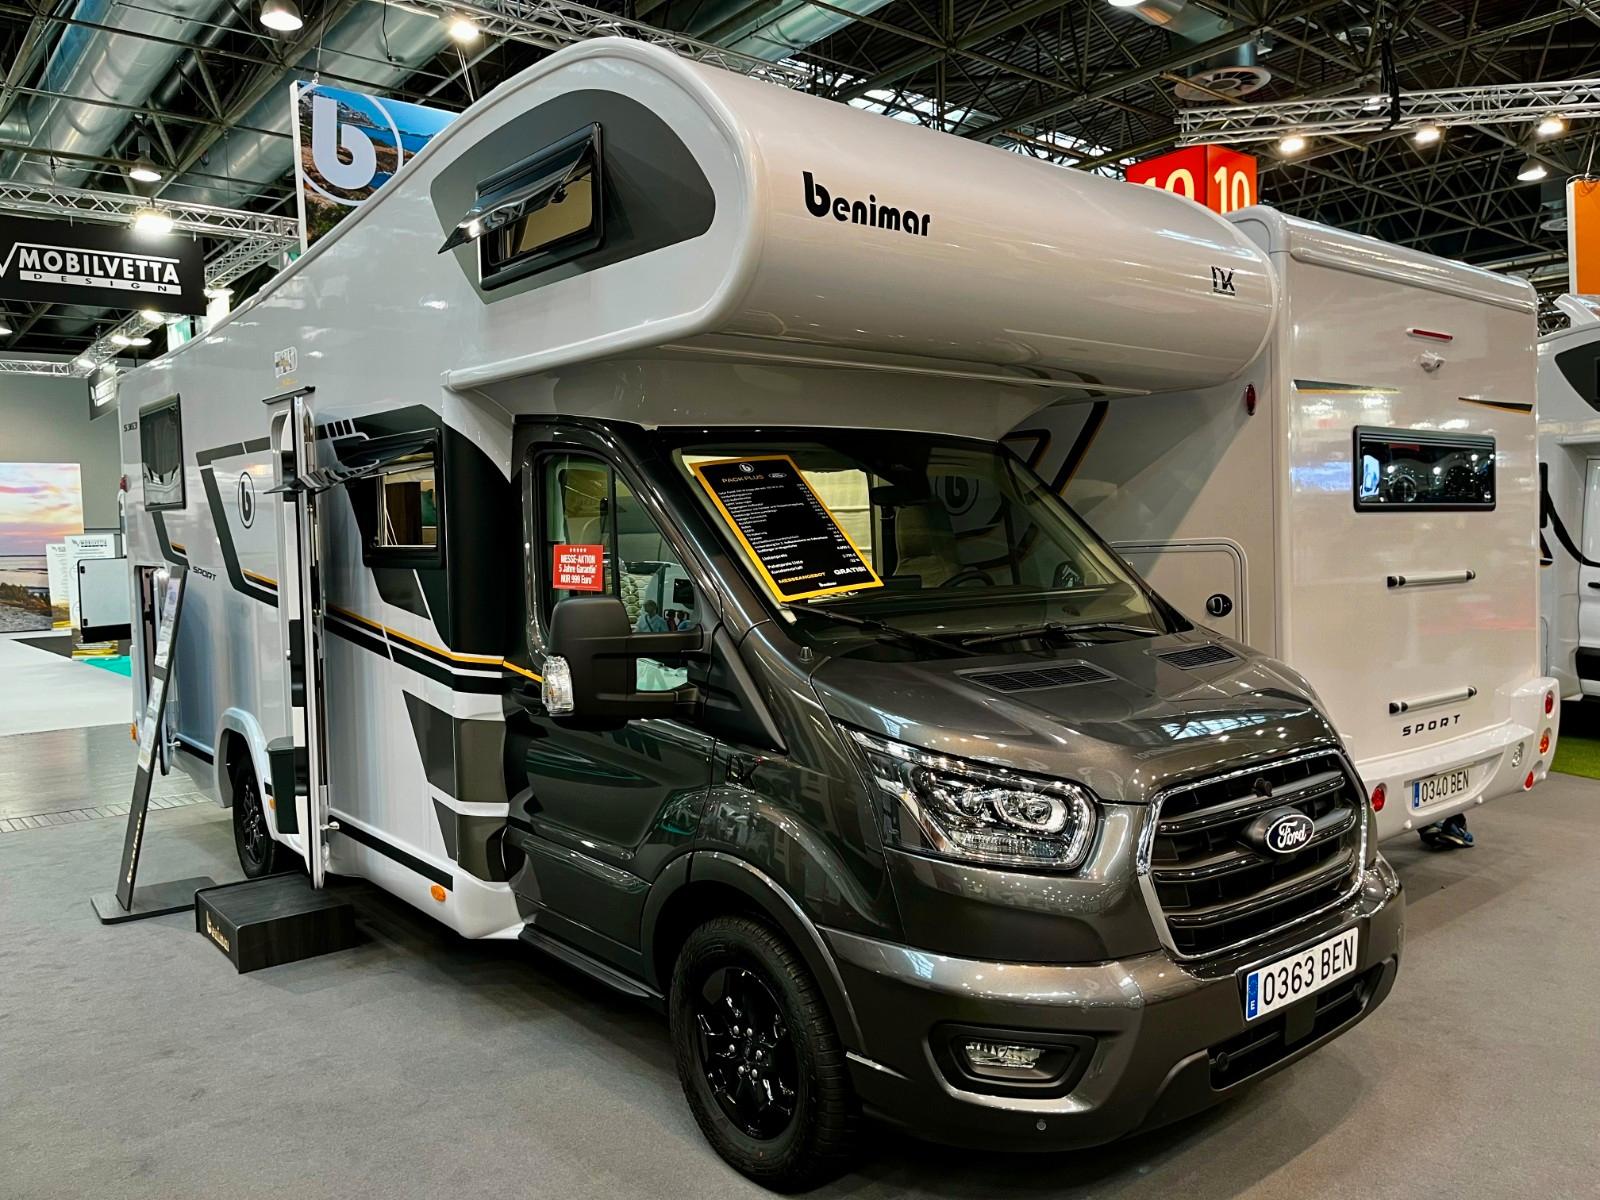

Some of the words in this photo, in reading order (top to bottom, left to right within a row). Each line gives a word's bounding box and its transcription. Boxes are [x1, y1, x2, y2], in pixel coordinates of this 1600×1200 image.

[313, 96, 377, 189] b
[802, 171, 930, 236] benimar
[1214, 166, 1250, 214] 10
[19, 248, 179, 284] MOBILVETTA
[33, 272, 167, 292] DESIGN
[745, 474, 765, 482] PLUS
[241, 481, 252, 521] b
[192, 566, 216, 580] SPORT
[560, 574, 571, 584] NUR
[1402, 714, 1460, 736] SPORT
[1421, 776, 1448, 802] 0340
[1450, 769, 1469, 794] BEN
[1276, 819, 1307, 848] Ford
[1262, 955, 1315, 1006] 0363
[1321, 935, 1353, 981] BEN
